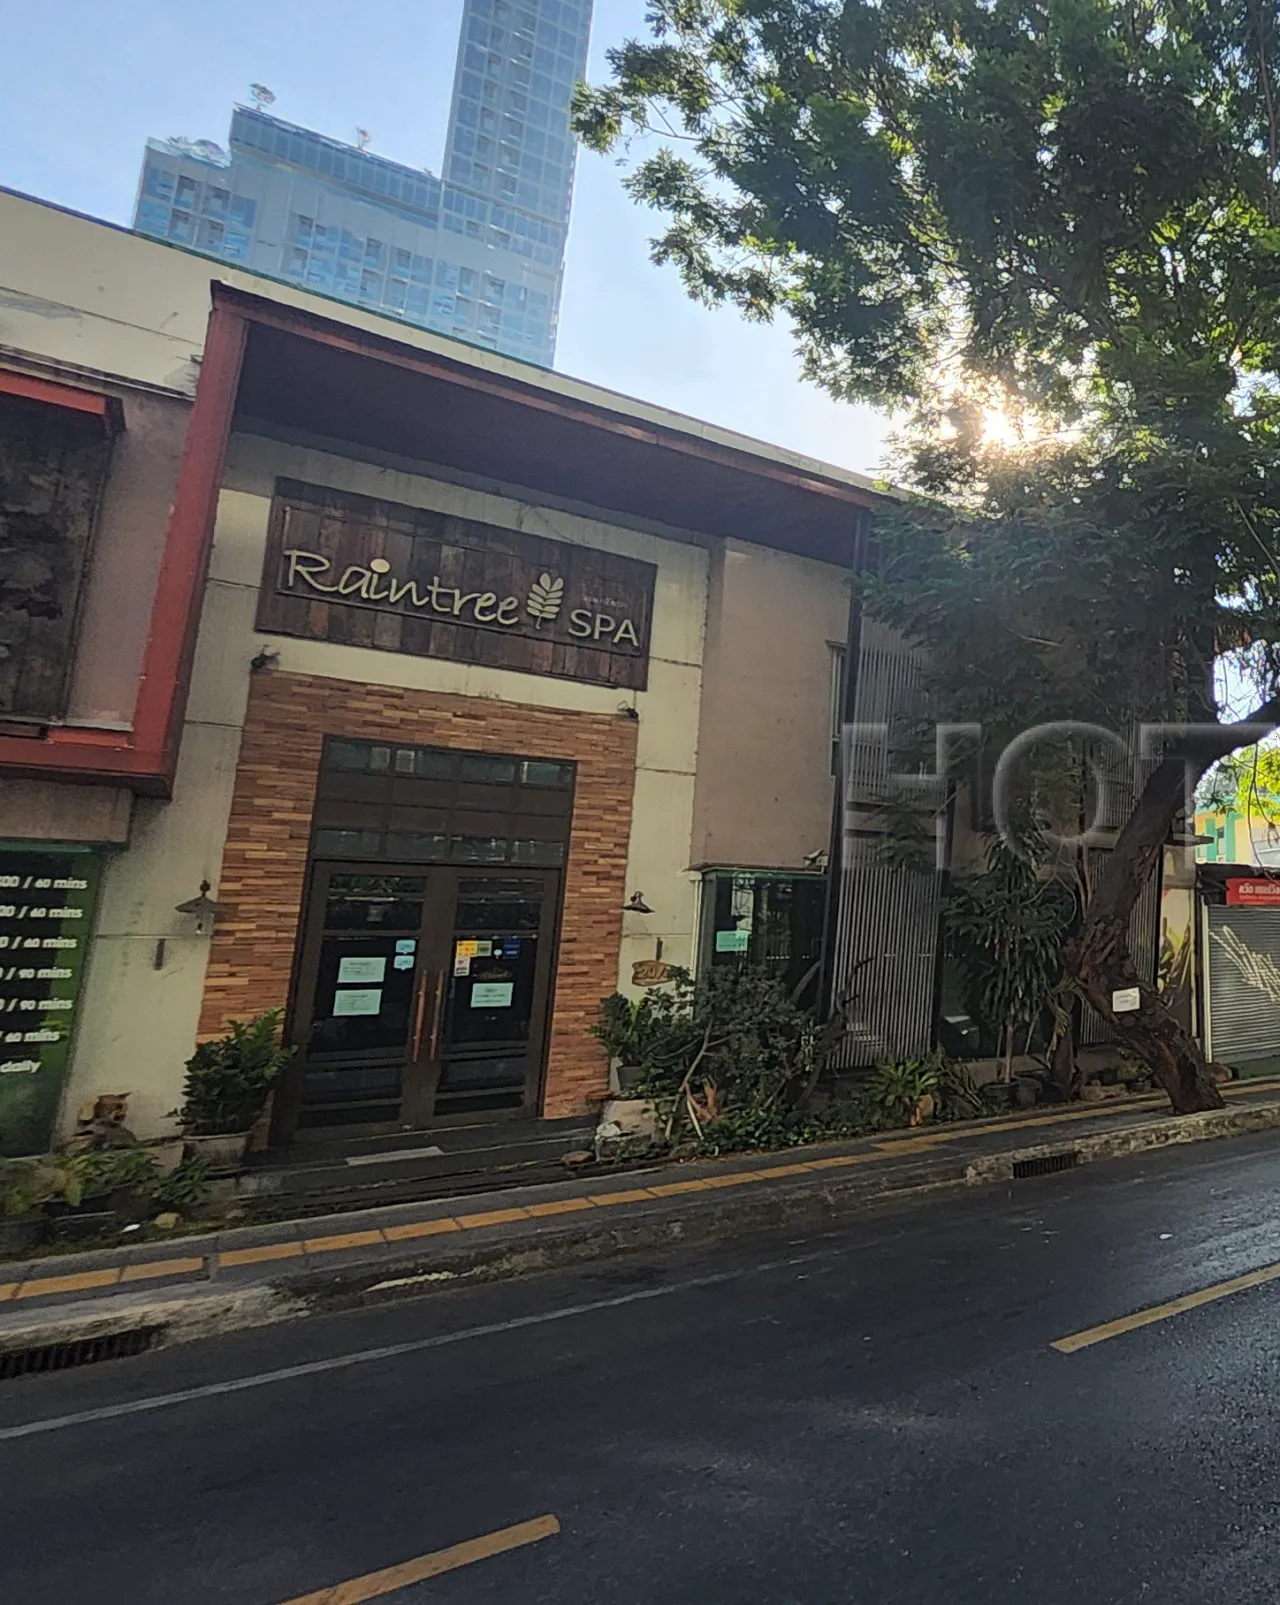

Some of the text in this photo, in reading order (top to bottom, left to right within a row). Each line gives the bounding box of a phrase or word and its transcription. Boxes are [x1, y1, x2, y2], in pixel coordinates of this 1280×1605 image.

[283, 548, 640, 647] Raintree SPA
[53, 876, 88, 890] mins
[48, 906, 83, 919] mins
[42, 935, 77, 949] mins
[37, 966, 73, 979] mins
[38, 997, 73, 1010] mins
[23, 1028, 61, 1042] mins
